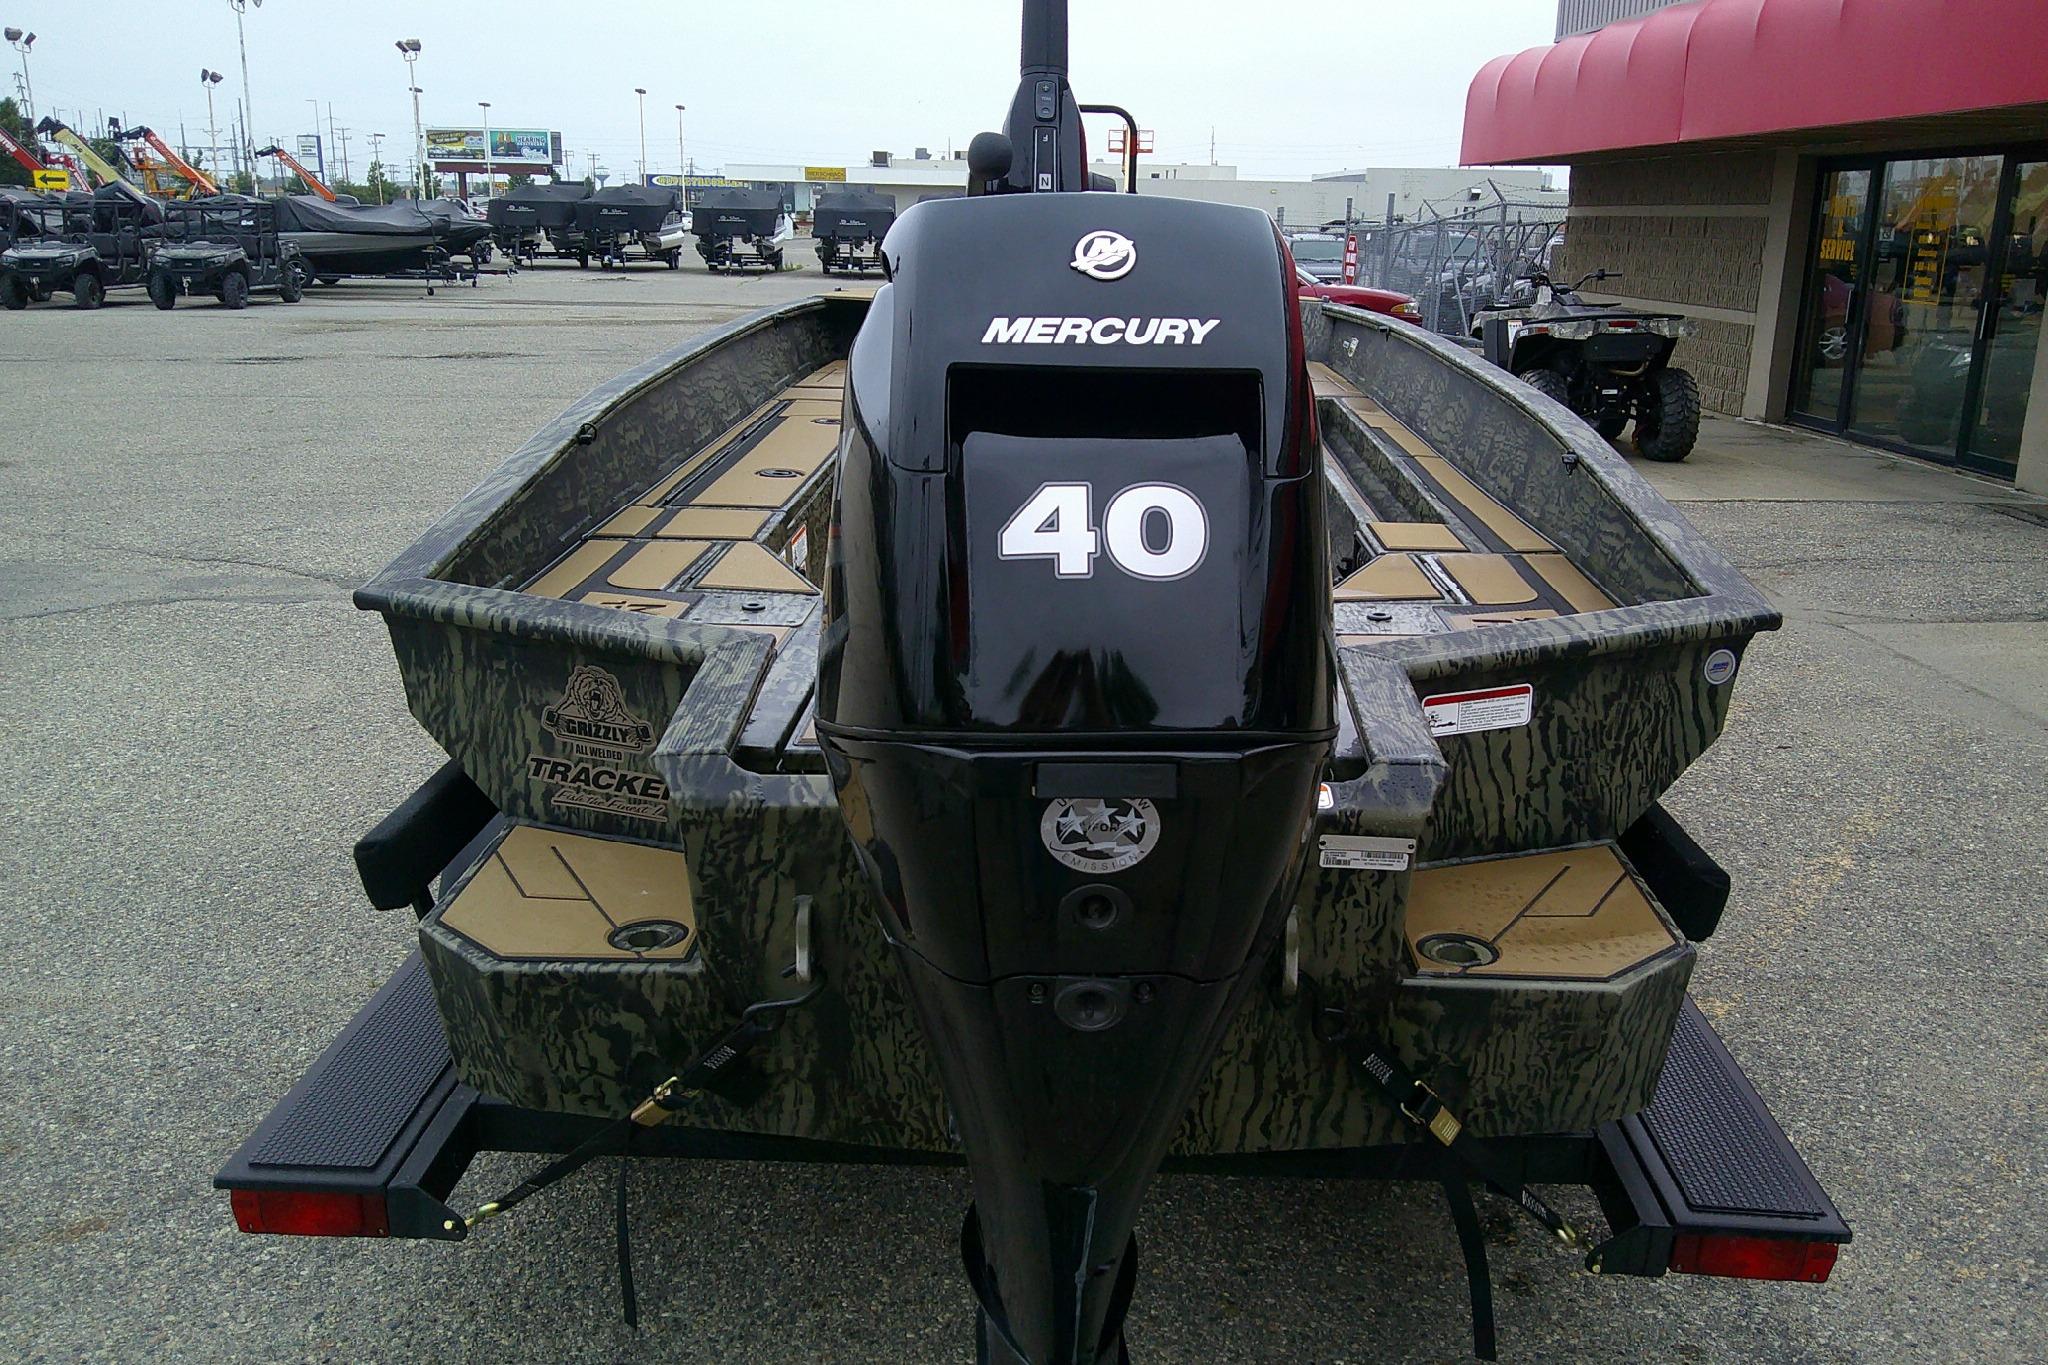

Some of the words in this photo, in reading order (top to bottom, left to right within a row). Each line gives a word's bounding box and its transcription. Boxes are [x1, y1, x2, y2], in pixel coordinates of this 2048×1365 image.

[1041, 177, 1049, 186] N
[1820, 239, 1856, 261] SERVICE
[981, 317, 1221, 345] MERCURY
[998, 481, 1210, 582] 40
[565, 718, 630, 744] GRIZZLY
[575, 743, 589, 756] ALL
[589, 746, 623, 761] WELDED
[557, 790, 584, 802] Fish
[585, 793, 605, 806] the
